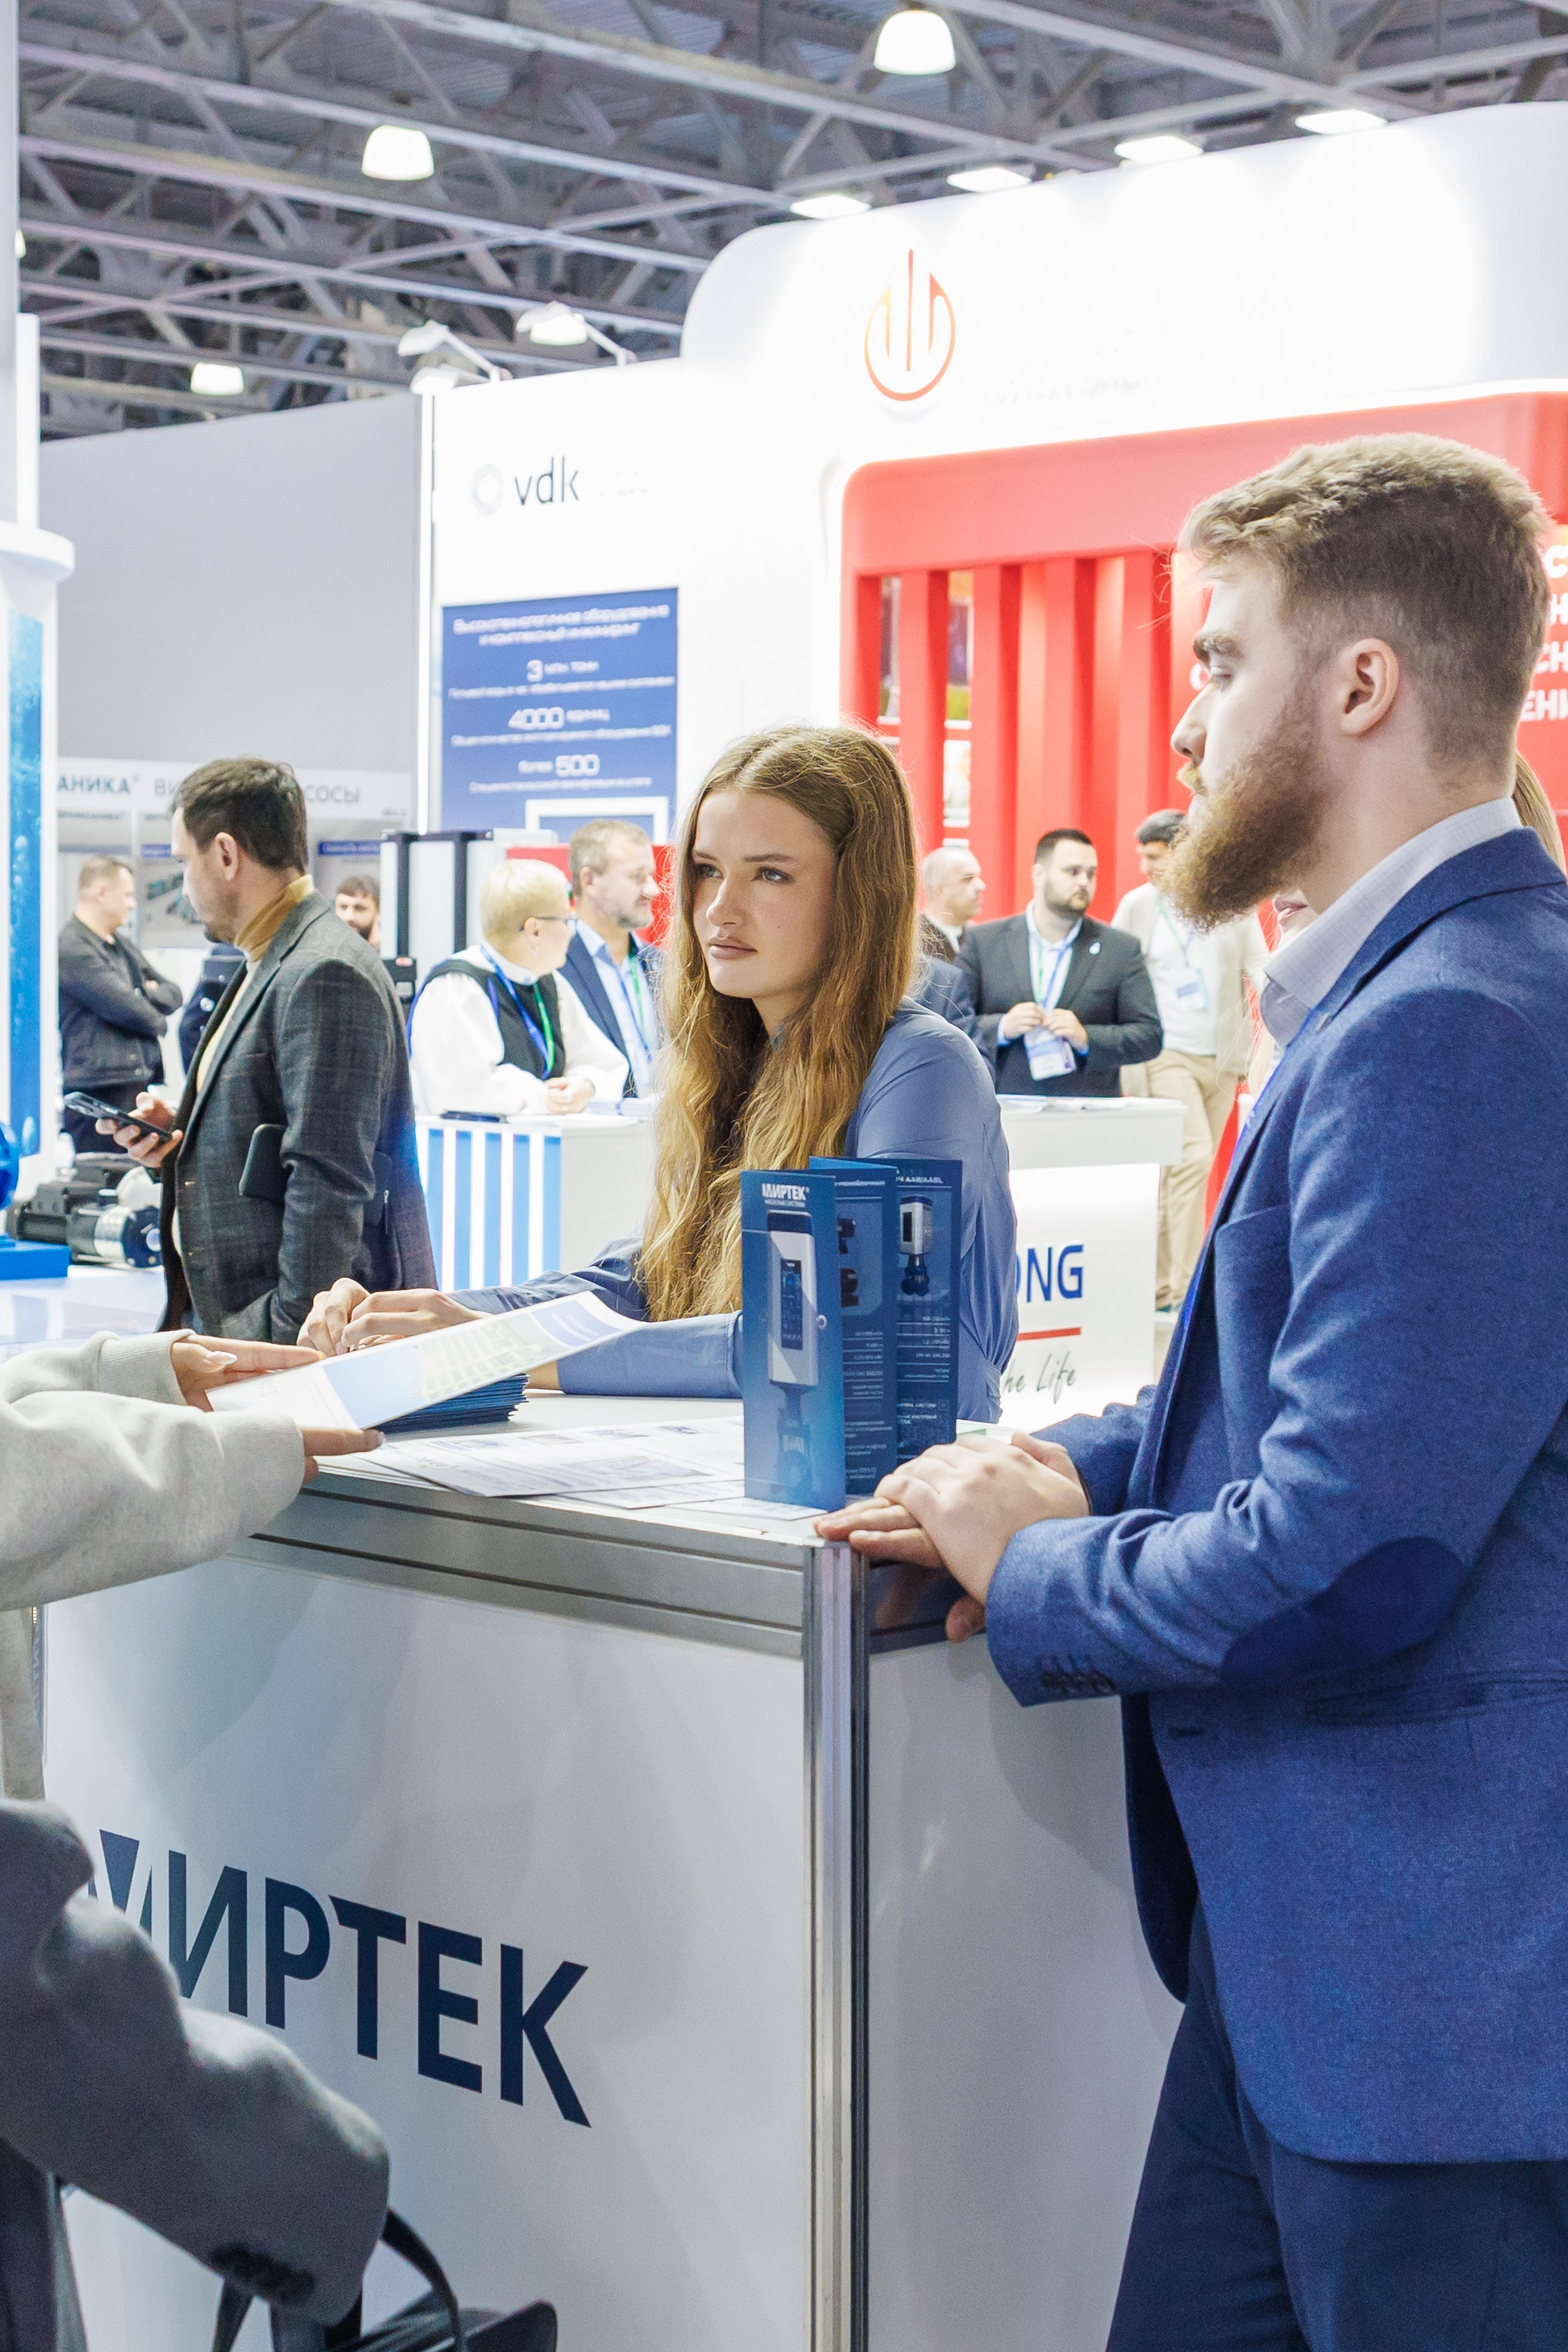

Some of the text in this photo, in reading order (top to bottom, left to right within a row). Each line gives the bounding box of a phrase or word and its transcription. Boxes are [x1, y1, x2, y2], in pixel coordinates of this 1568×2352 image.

[514, 456, 579, 505] vdk
[526, 659, 543, 682] 3
[508, 707, 565, 730] 4000
[556, 753, 600, 777] 500
[57, 774, 130, 794] АНИКА
[304, 785, 361, 804] СОСЫ
[1016, 1243, 1084, 1303] NG
[1036, 1351, 1077, 1404] Life
